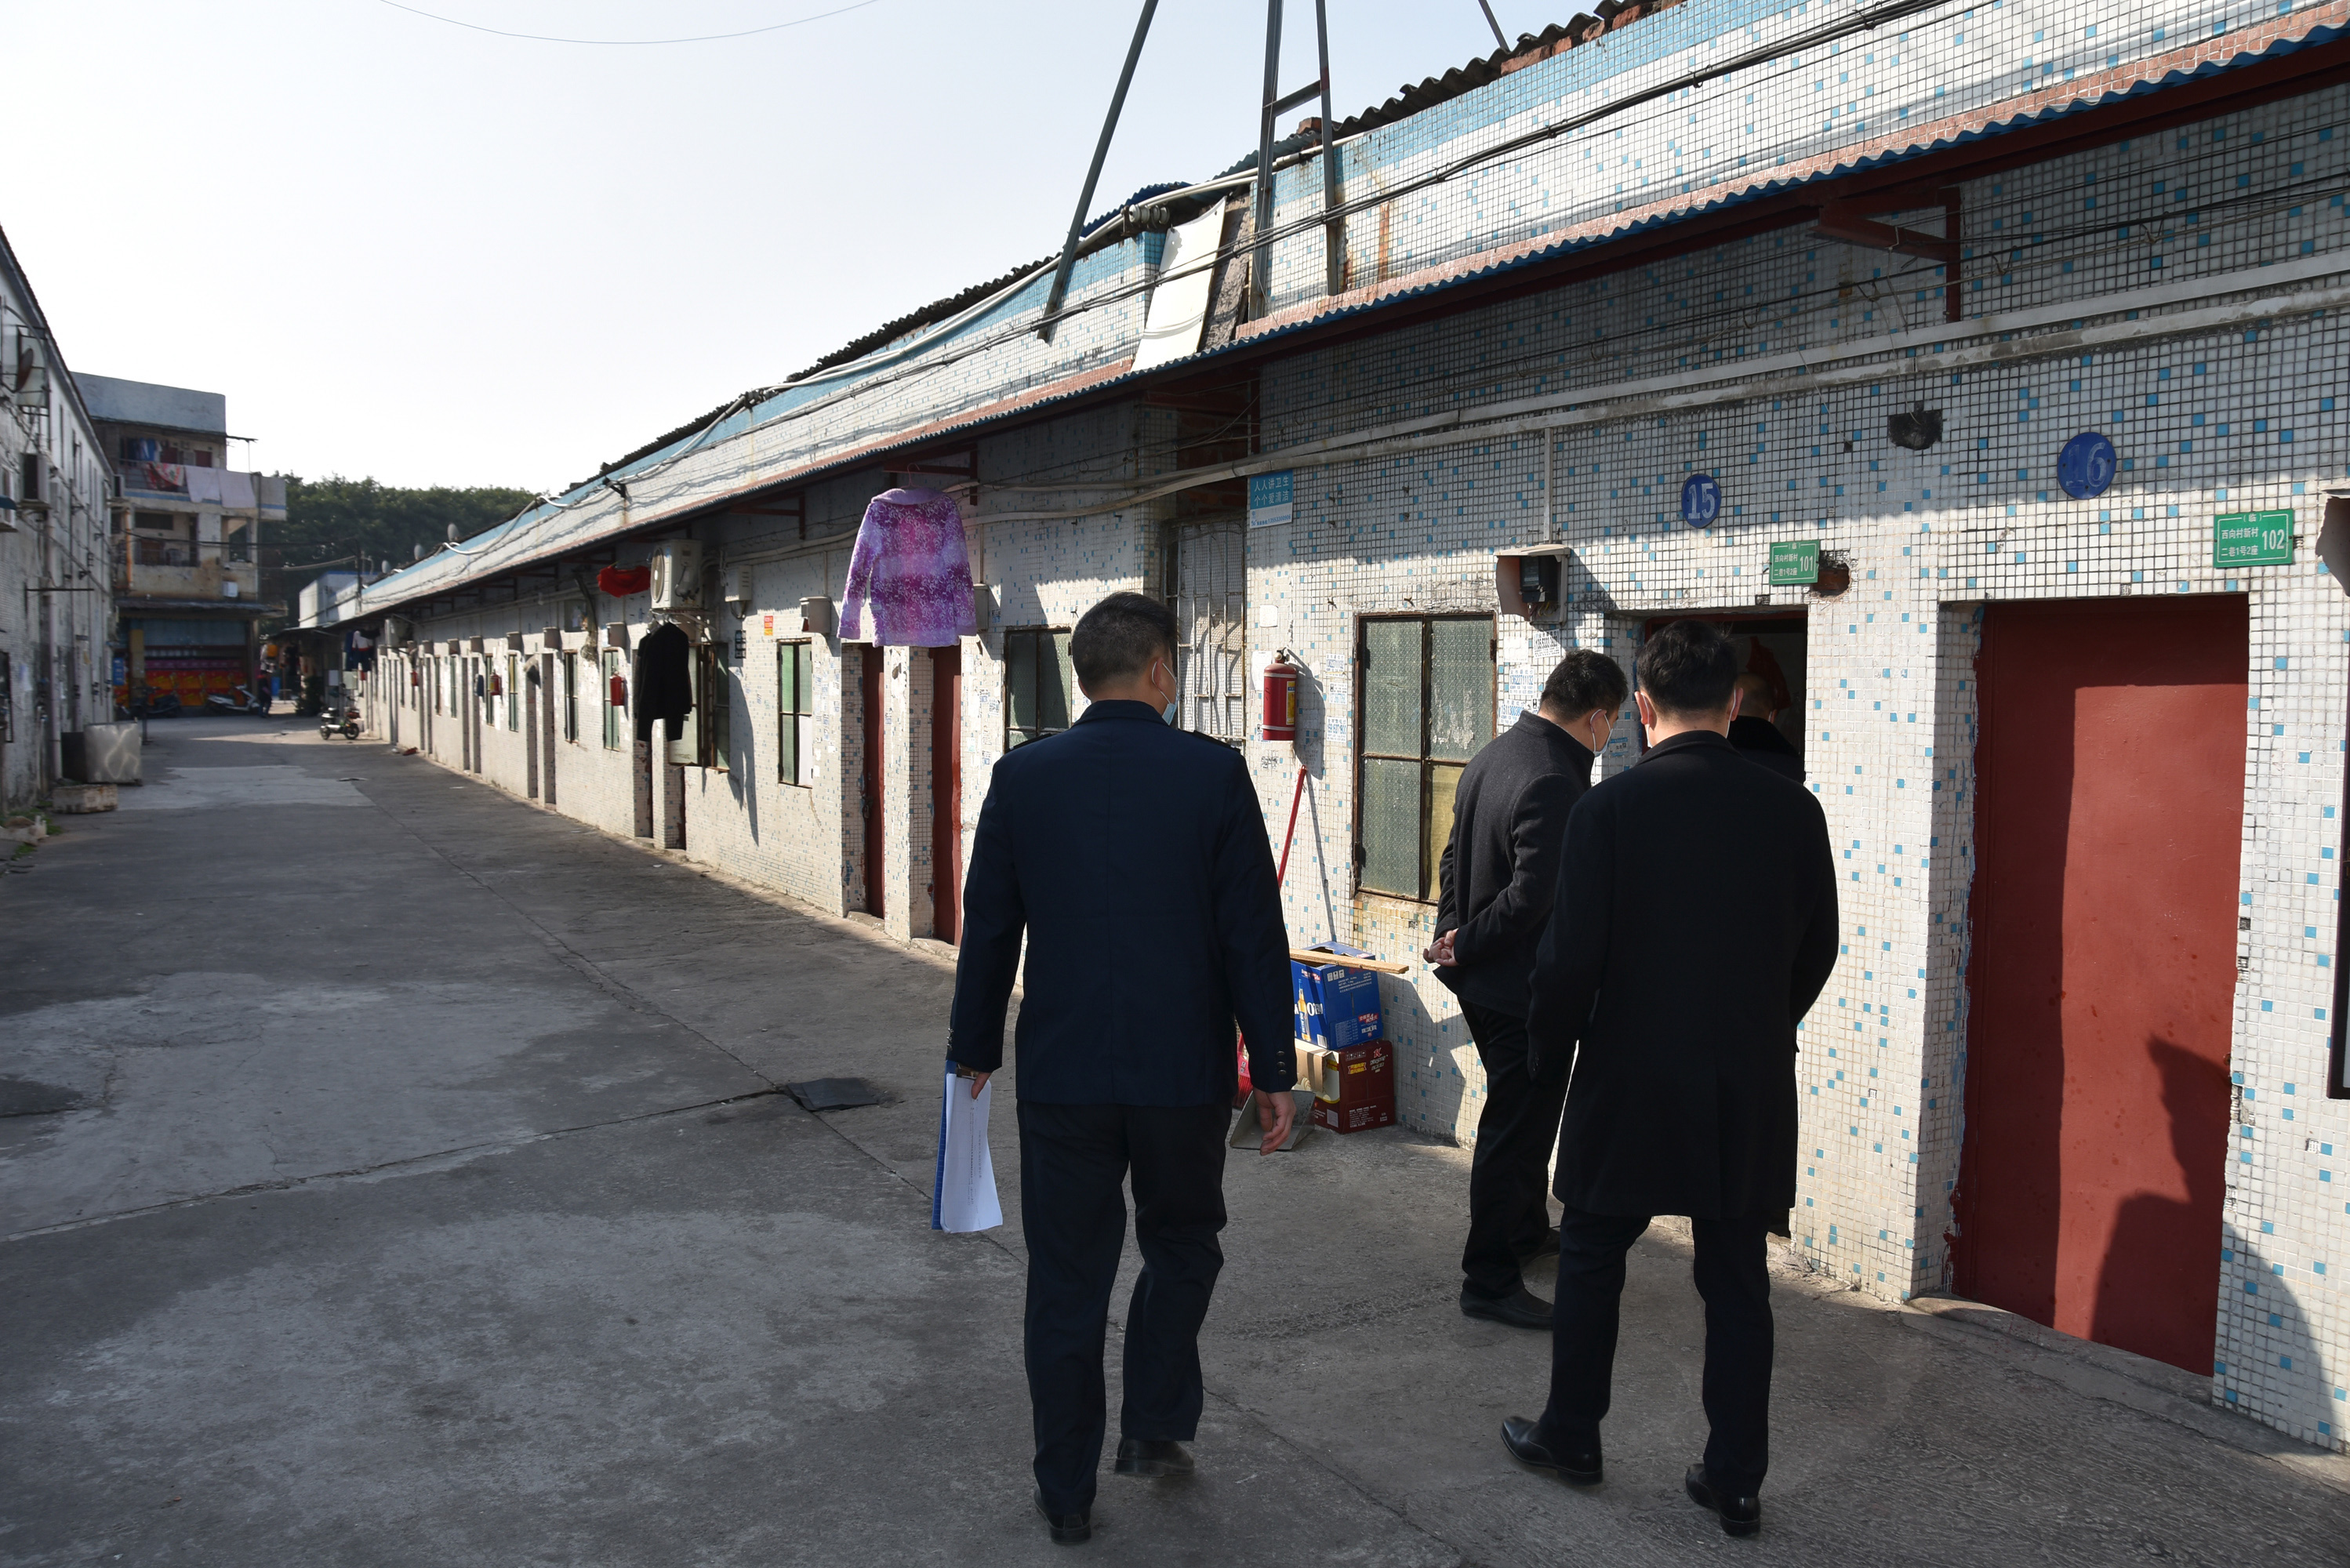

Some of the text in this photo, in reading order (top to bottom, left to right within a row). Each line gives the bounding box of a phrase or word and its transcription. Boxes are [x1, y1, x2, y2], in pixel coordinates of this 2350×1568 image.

[2065, 442, 2107, 488] 16
[1255, 475, 1289, 492] 人人讲卫生
[1255, 491, 1289, 506] 个个爱清洁
[1688, 483, 1715, 519] 15
[2221, 527, 2259, 539] 西向村新村
[2261, 529, 2285, 550] 102
[1774, 554, 1798, 563] 西向村新村
[2221, 545, 2258, 557] 二巷1号2座
[1800, 555, 1814, 572] 101
